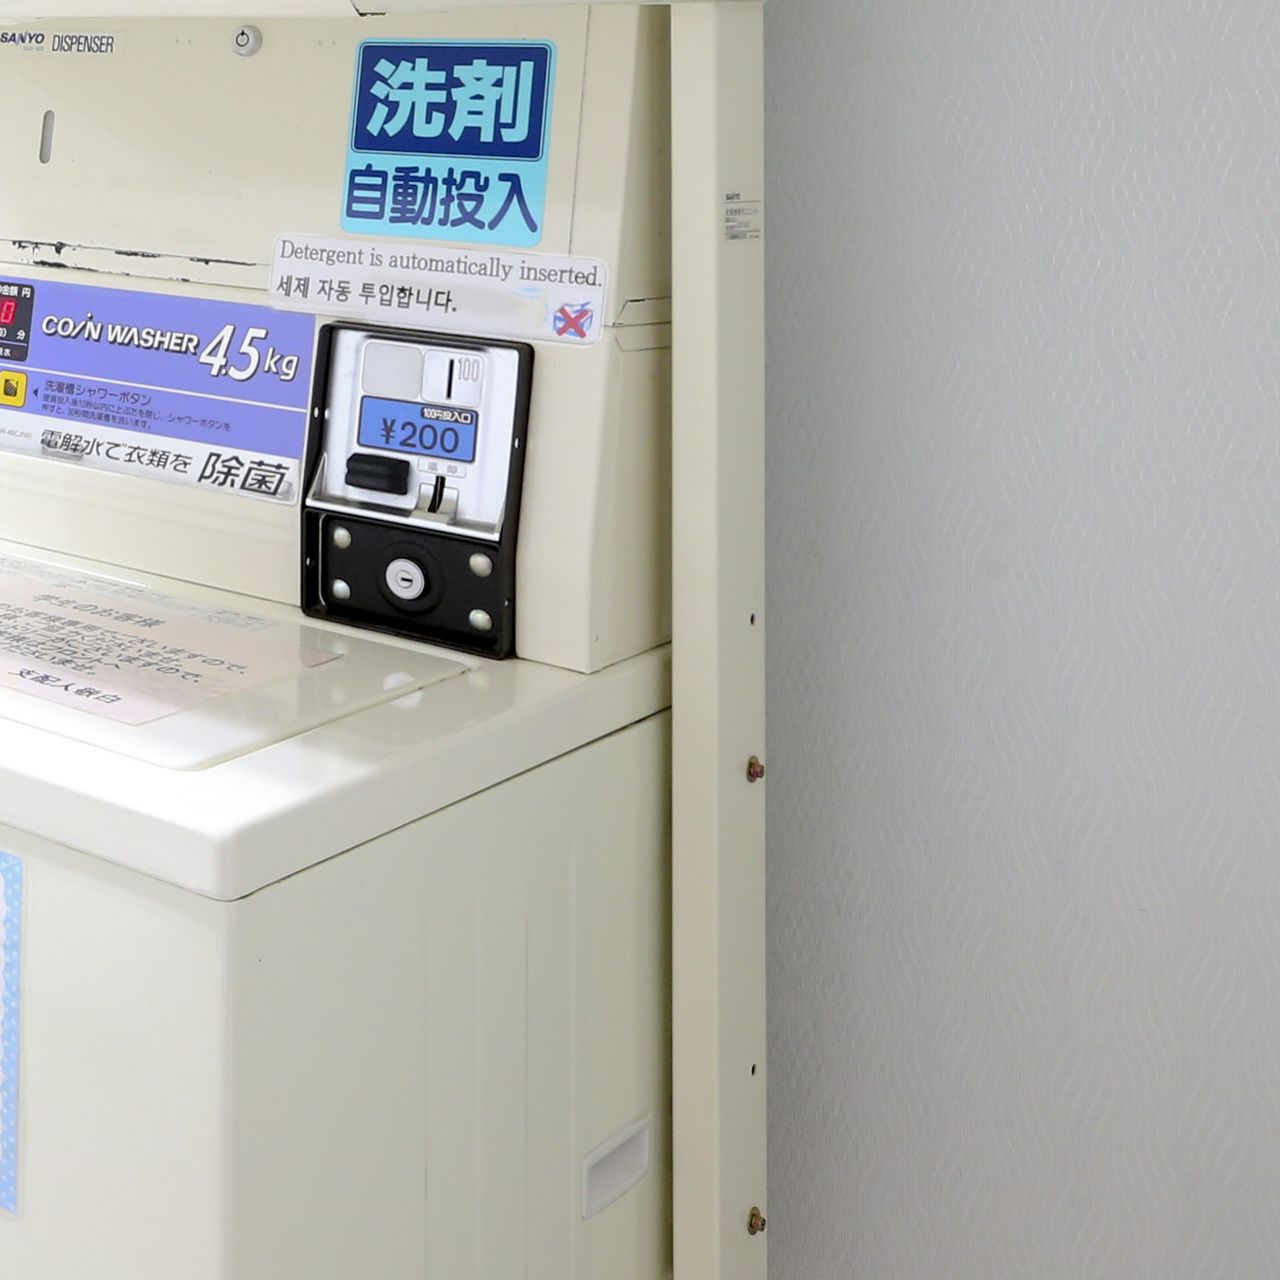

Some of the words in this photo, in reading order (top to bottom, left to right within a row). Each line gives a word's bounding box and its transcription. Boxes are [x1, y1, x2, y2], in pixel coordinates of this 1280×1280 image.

[0, 31, 45, 45] SANYO
[51, 34, 115, 54] DISPENSER
[366, 57, 535, 143] 洗剤
[345, 163, 538, 233] 自動投入
[280, 239, 365, 268] Detergent
[369, 247, 384, 266] is
[388, 253, 513, 282] automatically
[519, 261, 603, 288] inserted.
[21, 287, 32, 299] 円
[276, 275, 310, 299] 세제
[317, 279, 352, 303] 자동
[358, 282, 457, 314] 투입합니다.
[16, 330, 26, 341] 分
[107, 324, 200, 355] WASHER
[457, 358, 481, 383] 100
[44, 380, 152, 406] 洗濯槽シャワーボタン
[380, 417, 459, 454] ¥200
[40, 429, 193, 474] 電解水で衣類を
[197, 452, 290, 496] 除菌
[32, 593, 166, 629] 学生のお客様
